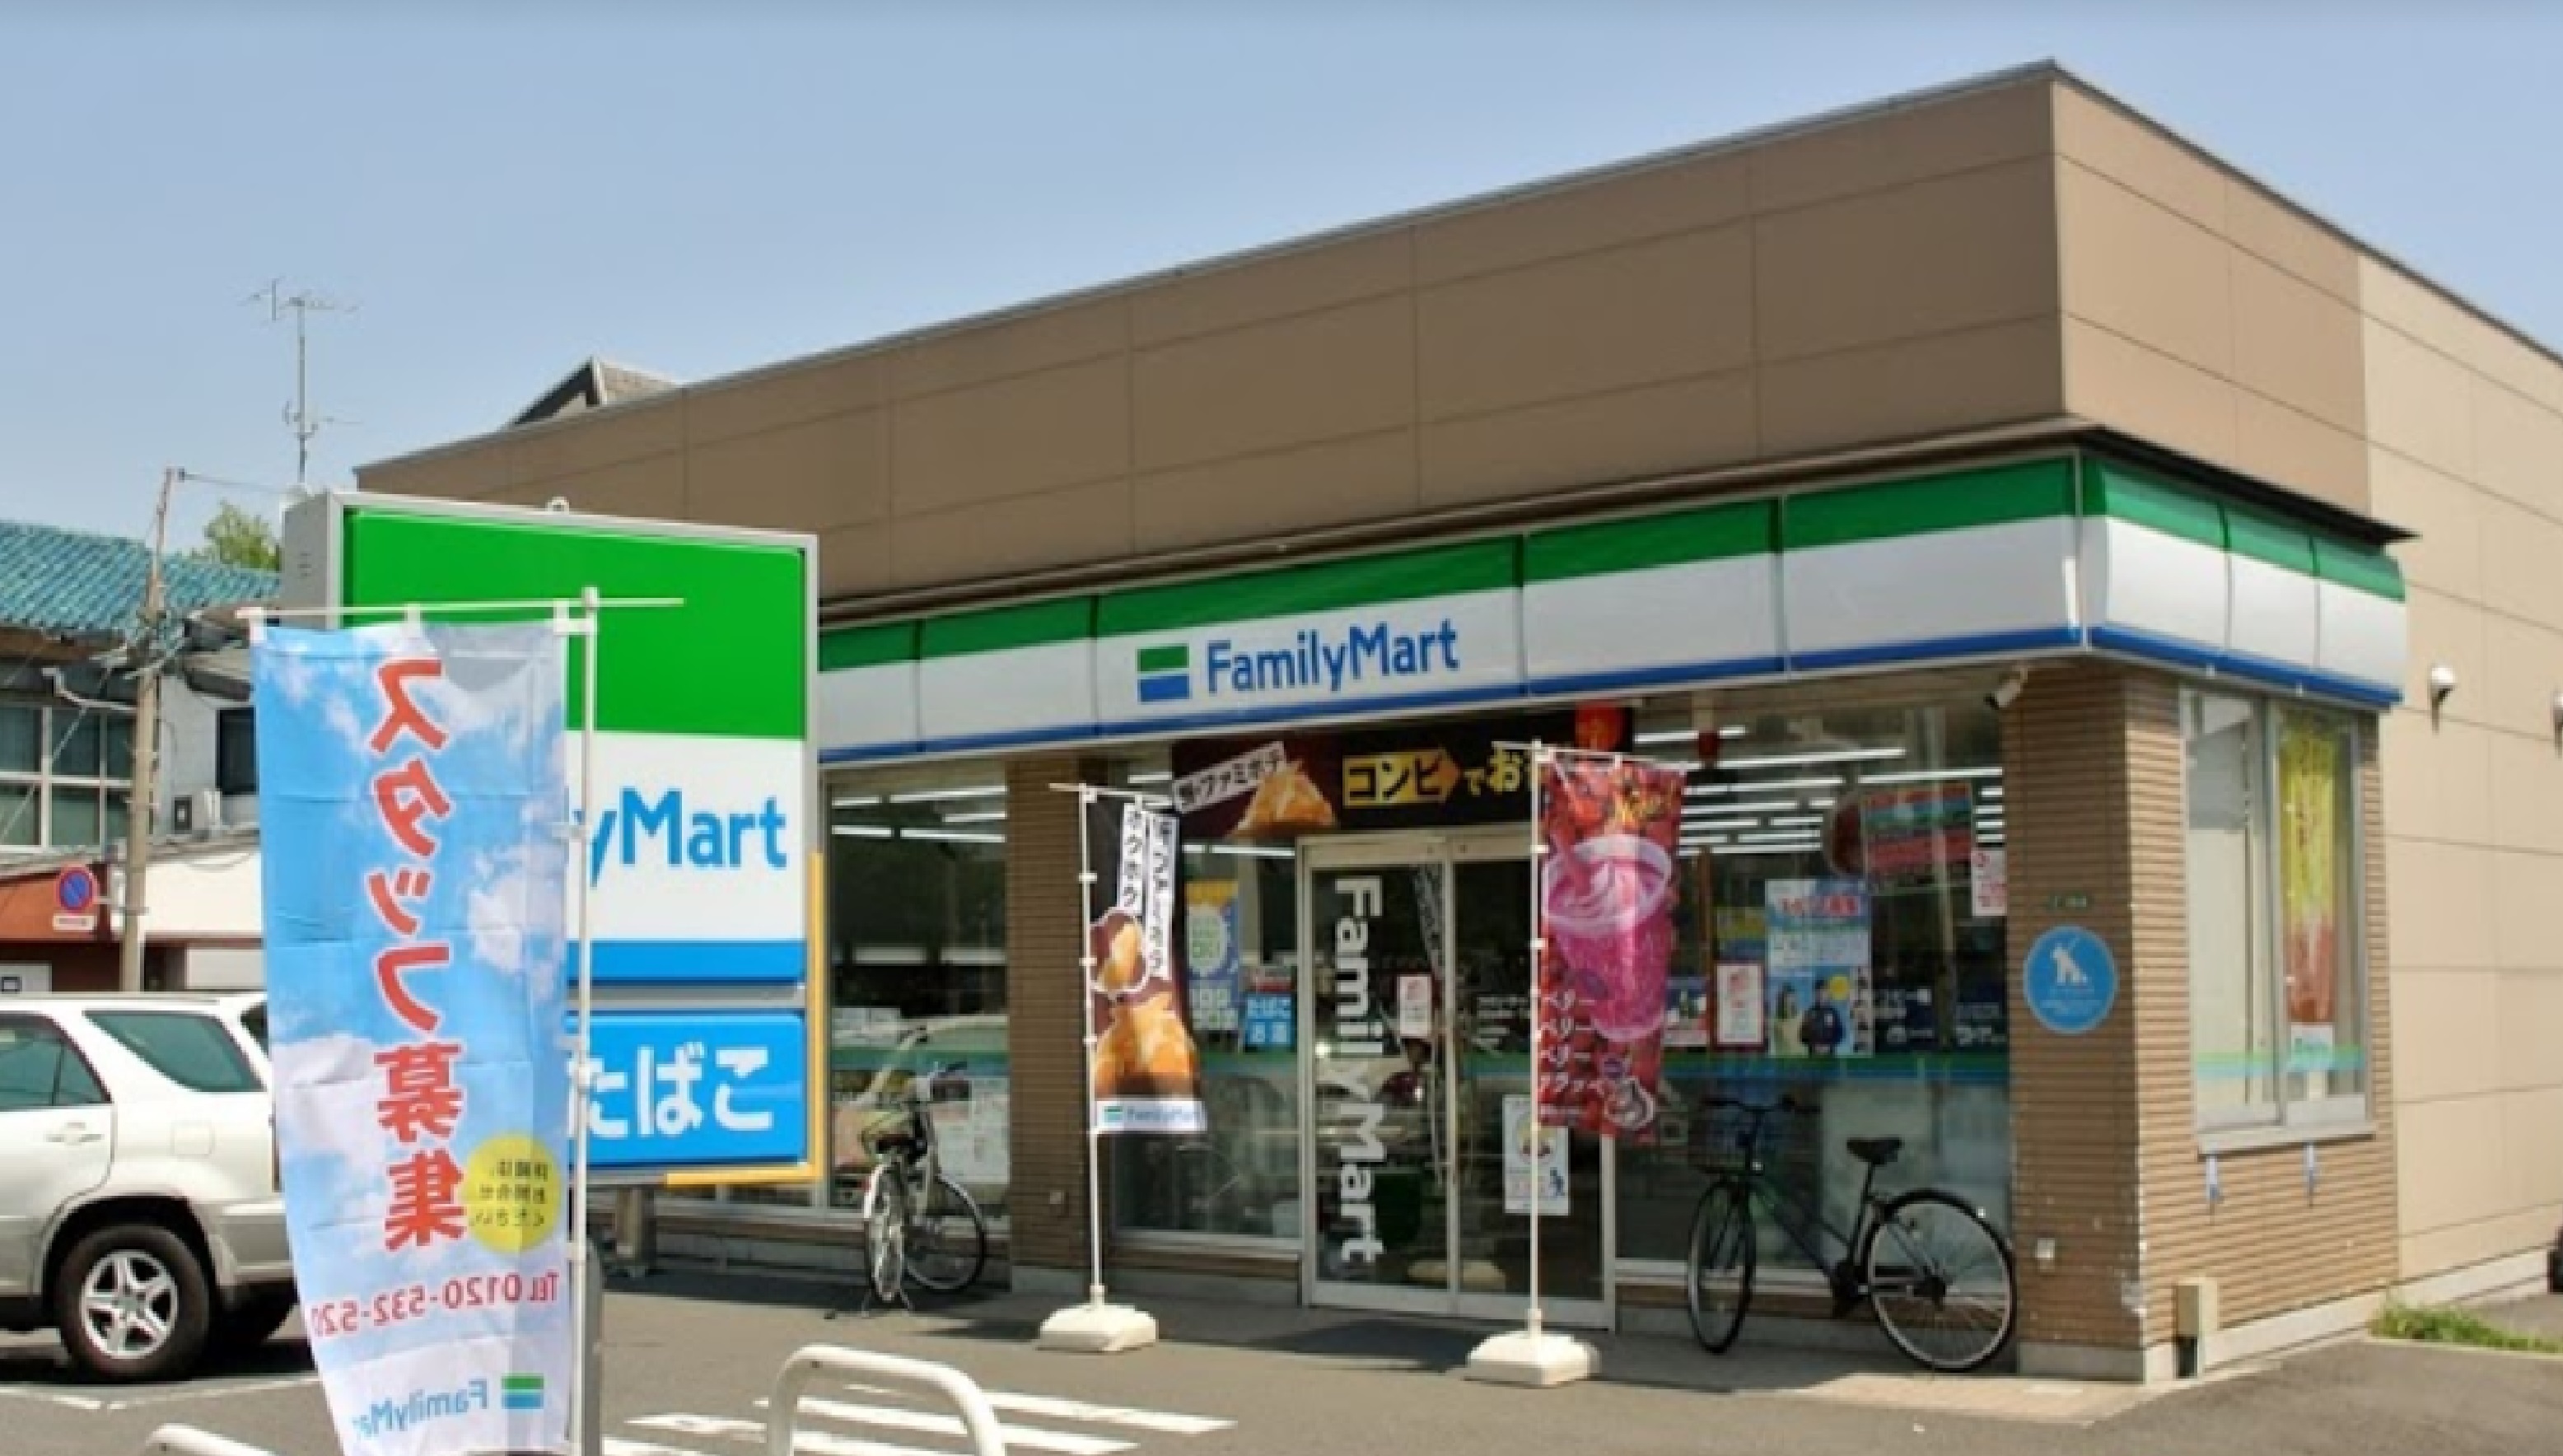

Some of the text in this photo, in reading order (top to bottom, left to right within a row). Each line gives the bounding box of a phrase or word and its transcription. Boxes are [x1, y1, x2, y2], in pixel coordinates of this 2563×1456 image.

[1207, 618, 1460, 693] FamilyMart
[567, 1041, 773, 1140] たばこ
[1318, 877, 1386, 1262] FamilyMart
